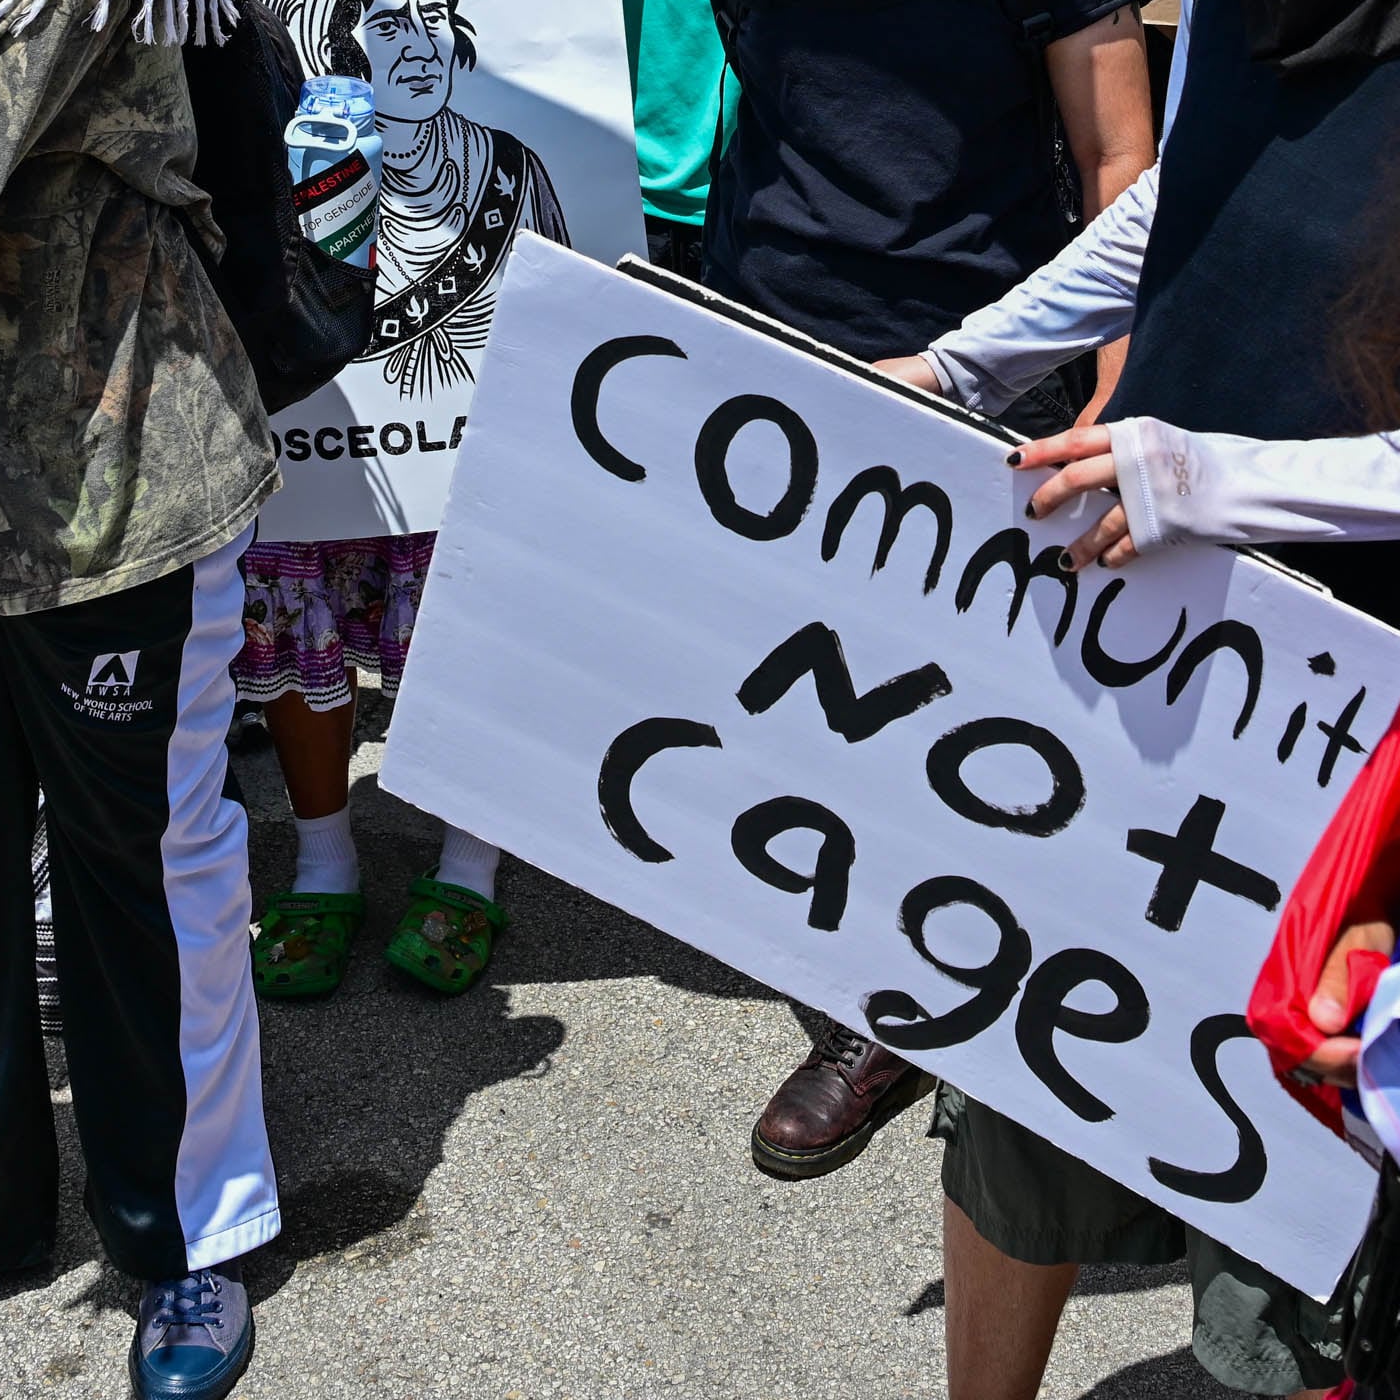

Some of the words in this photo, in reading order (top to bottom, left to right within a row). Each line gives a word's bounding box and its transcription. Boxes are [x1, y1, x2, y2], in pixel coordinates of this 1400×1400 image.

[301, 160, 361, 200] PALESTINE
[301, 217, 322, 236] TOP
[324, 181, 373, 223] GENOCIDE
[61, 683, 80, 700] NEW
[83, 698, 116, 712] WORLD
[118, 700, 153, 712] SCHOOL
[73, 702, 86, 712] OF
[88, 707, 106, 720] THE
[107, 712, 133, 722] ARTS
